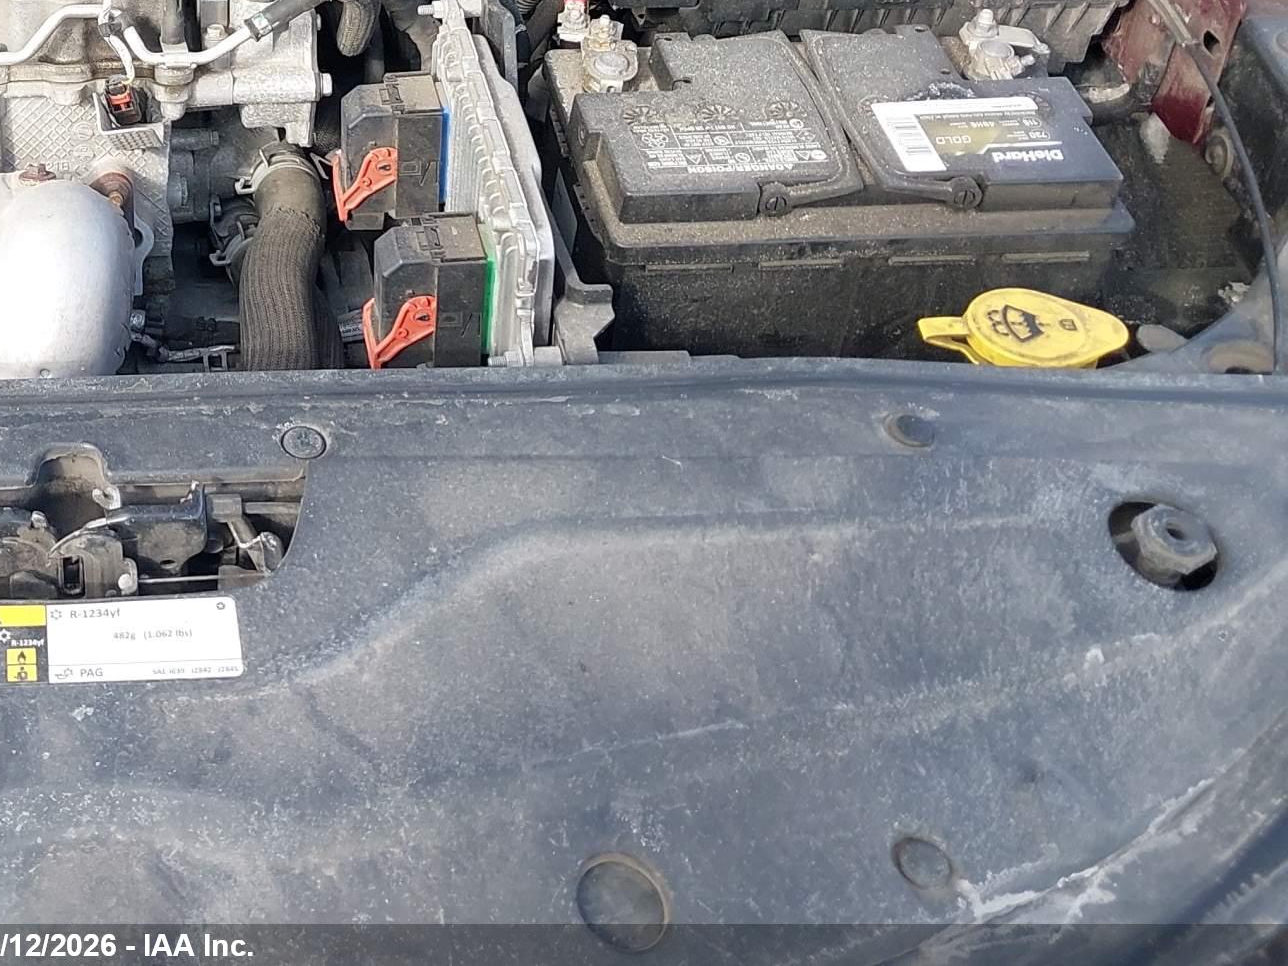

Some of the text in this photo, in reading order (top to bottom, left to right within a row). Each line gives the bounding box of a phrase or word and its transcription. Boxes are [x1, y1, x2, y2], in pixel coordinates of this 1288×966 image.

[935, 134, 972, 145] GOLD
[991, 148, 1065, 163] DieHard
[69, 608, 121, 622] R-1234yf
[11, 638, 45, 648] R-1234yf
[80, 667, 104, 678] PAG
